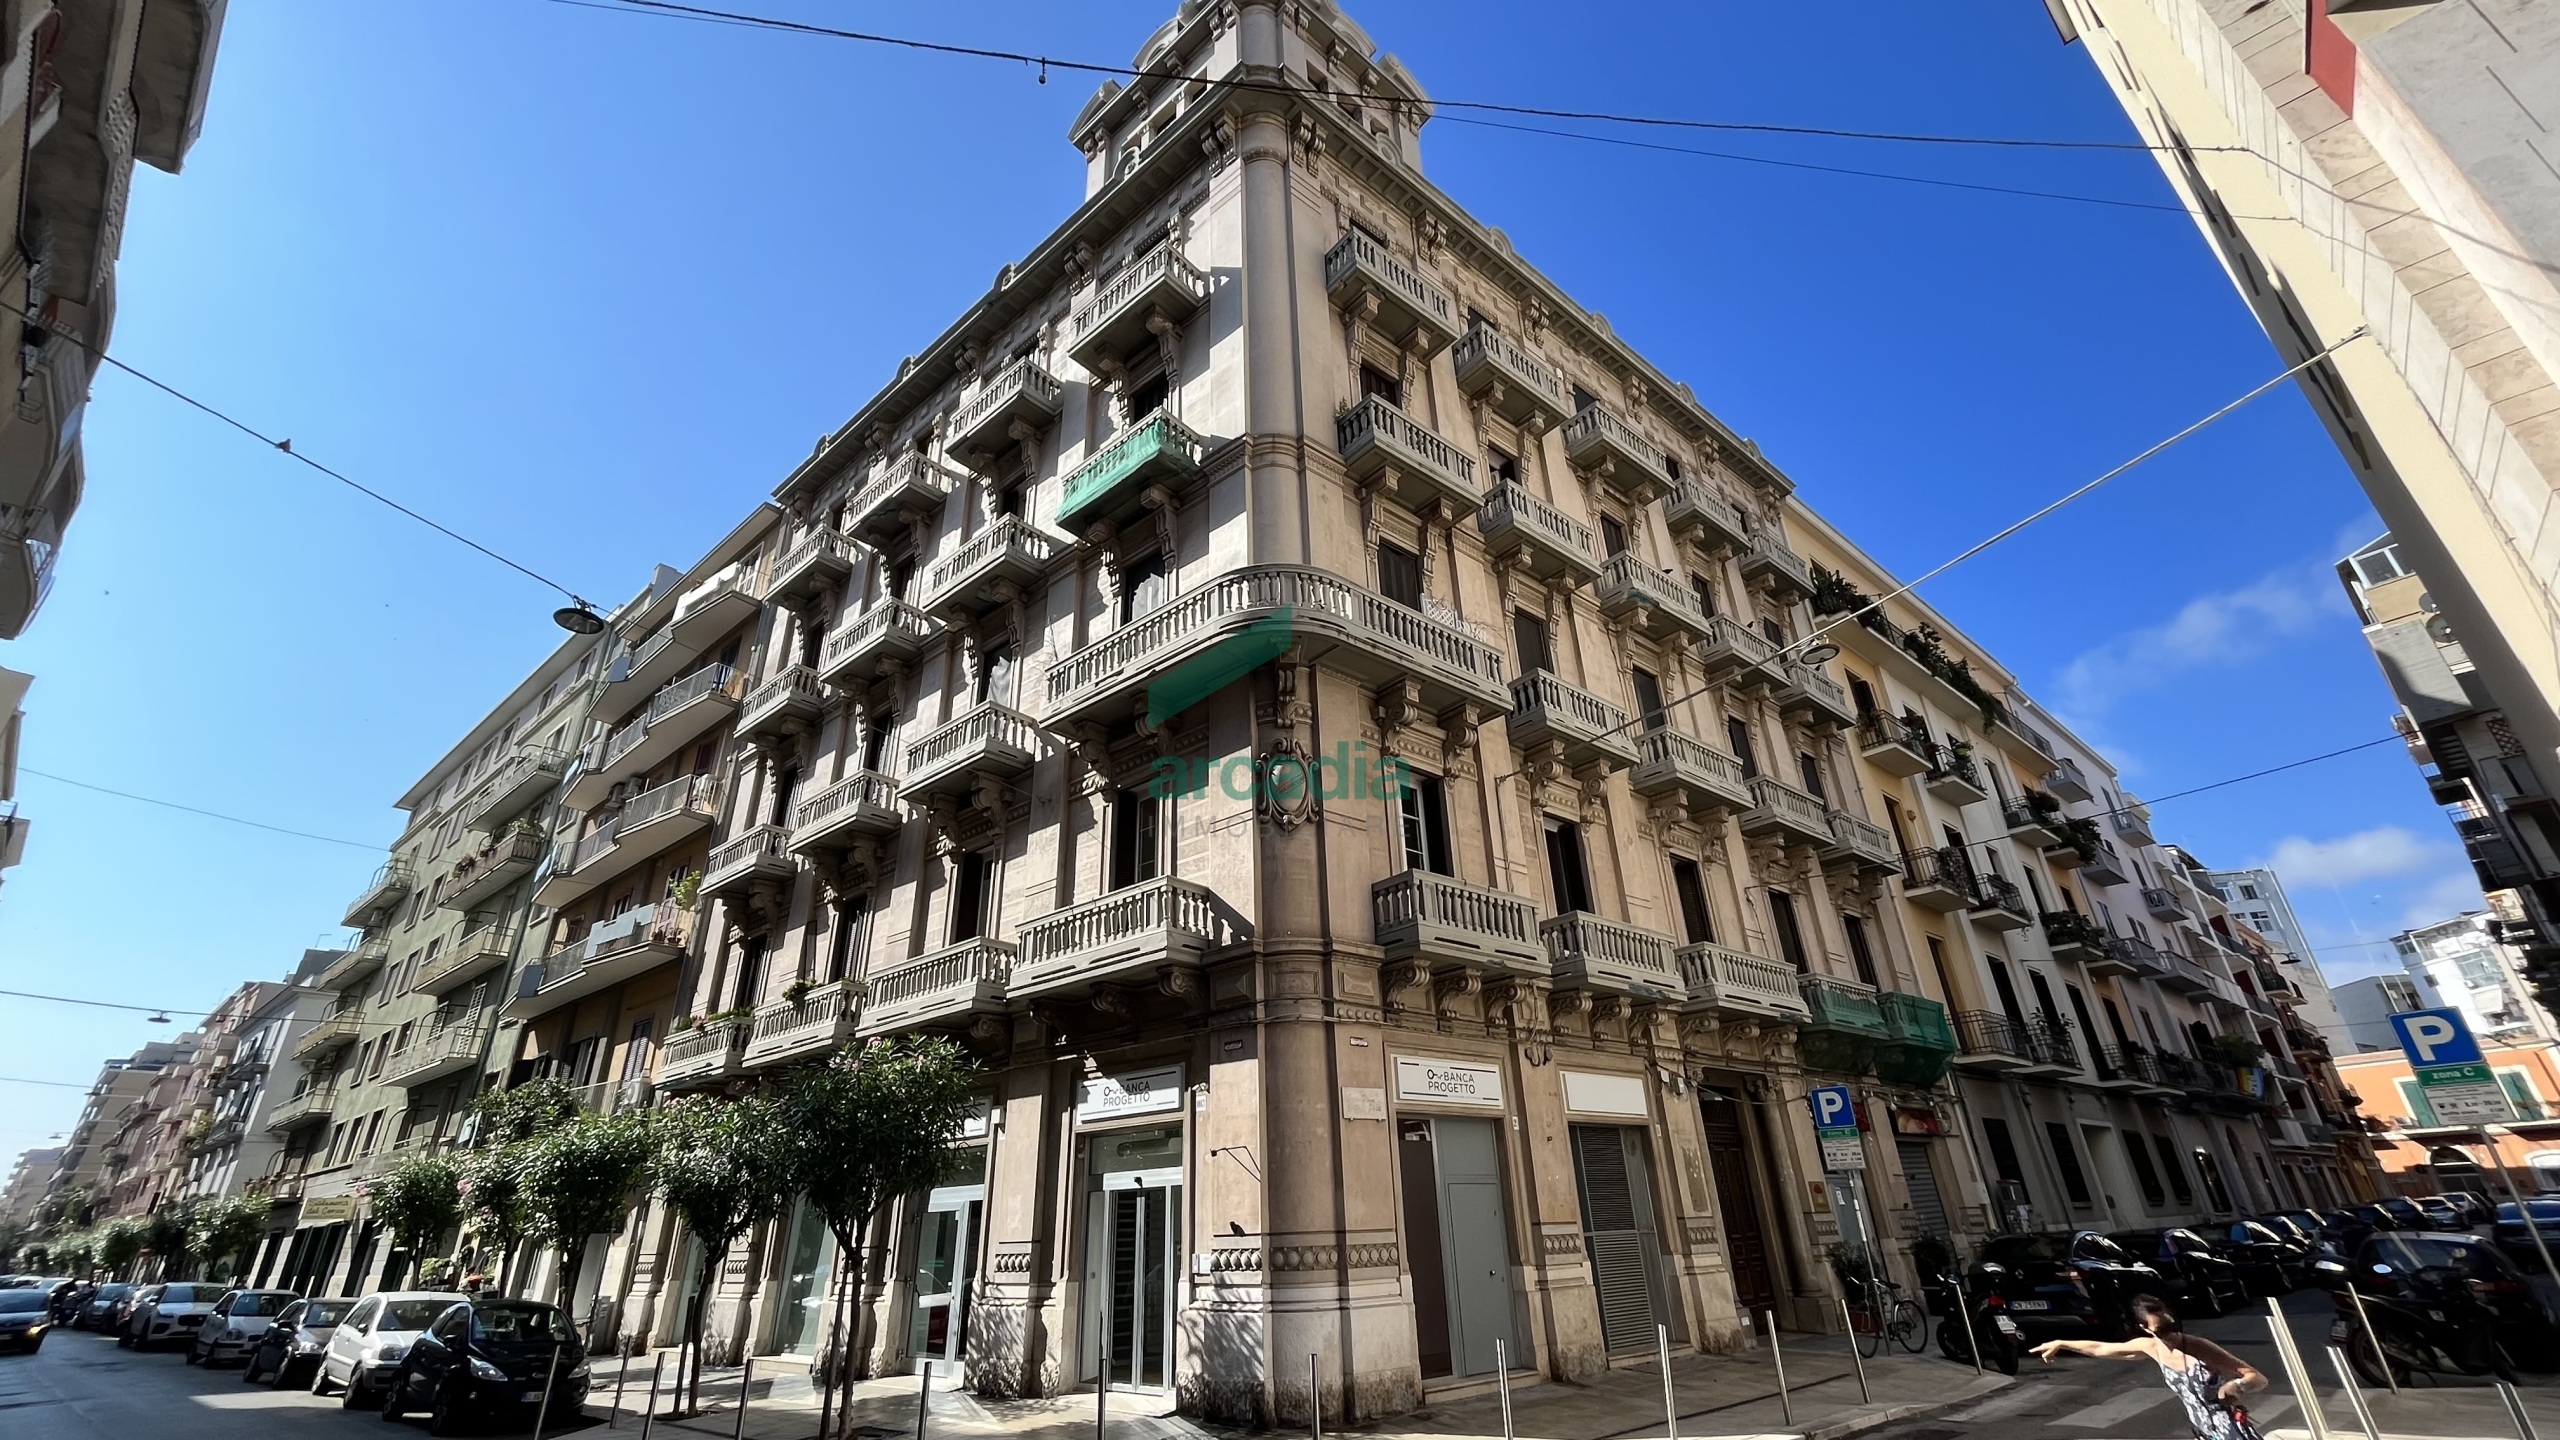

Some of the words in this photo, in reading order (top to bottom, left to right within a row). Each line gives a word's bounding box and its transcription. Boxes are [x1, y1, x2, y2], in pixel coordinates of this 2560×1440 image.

[2403, 1015, 2455, 1061] P
[1444, 1071, 1474, 1083] BANCA
[2432, 1070, 2461, 1079] zona
[2463, 1067, 2475, 1076] C
[1120, 1081, 1151, 1093] BANCA
[1428, 1081, 1476, 1094] PROGETTO
[1103, 1092, 1151, 1107] PROGETTO
[1818, 1091, 1843, 1124] P
